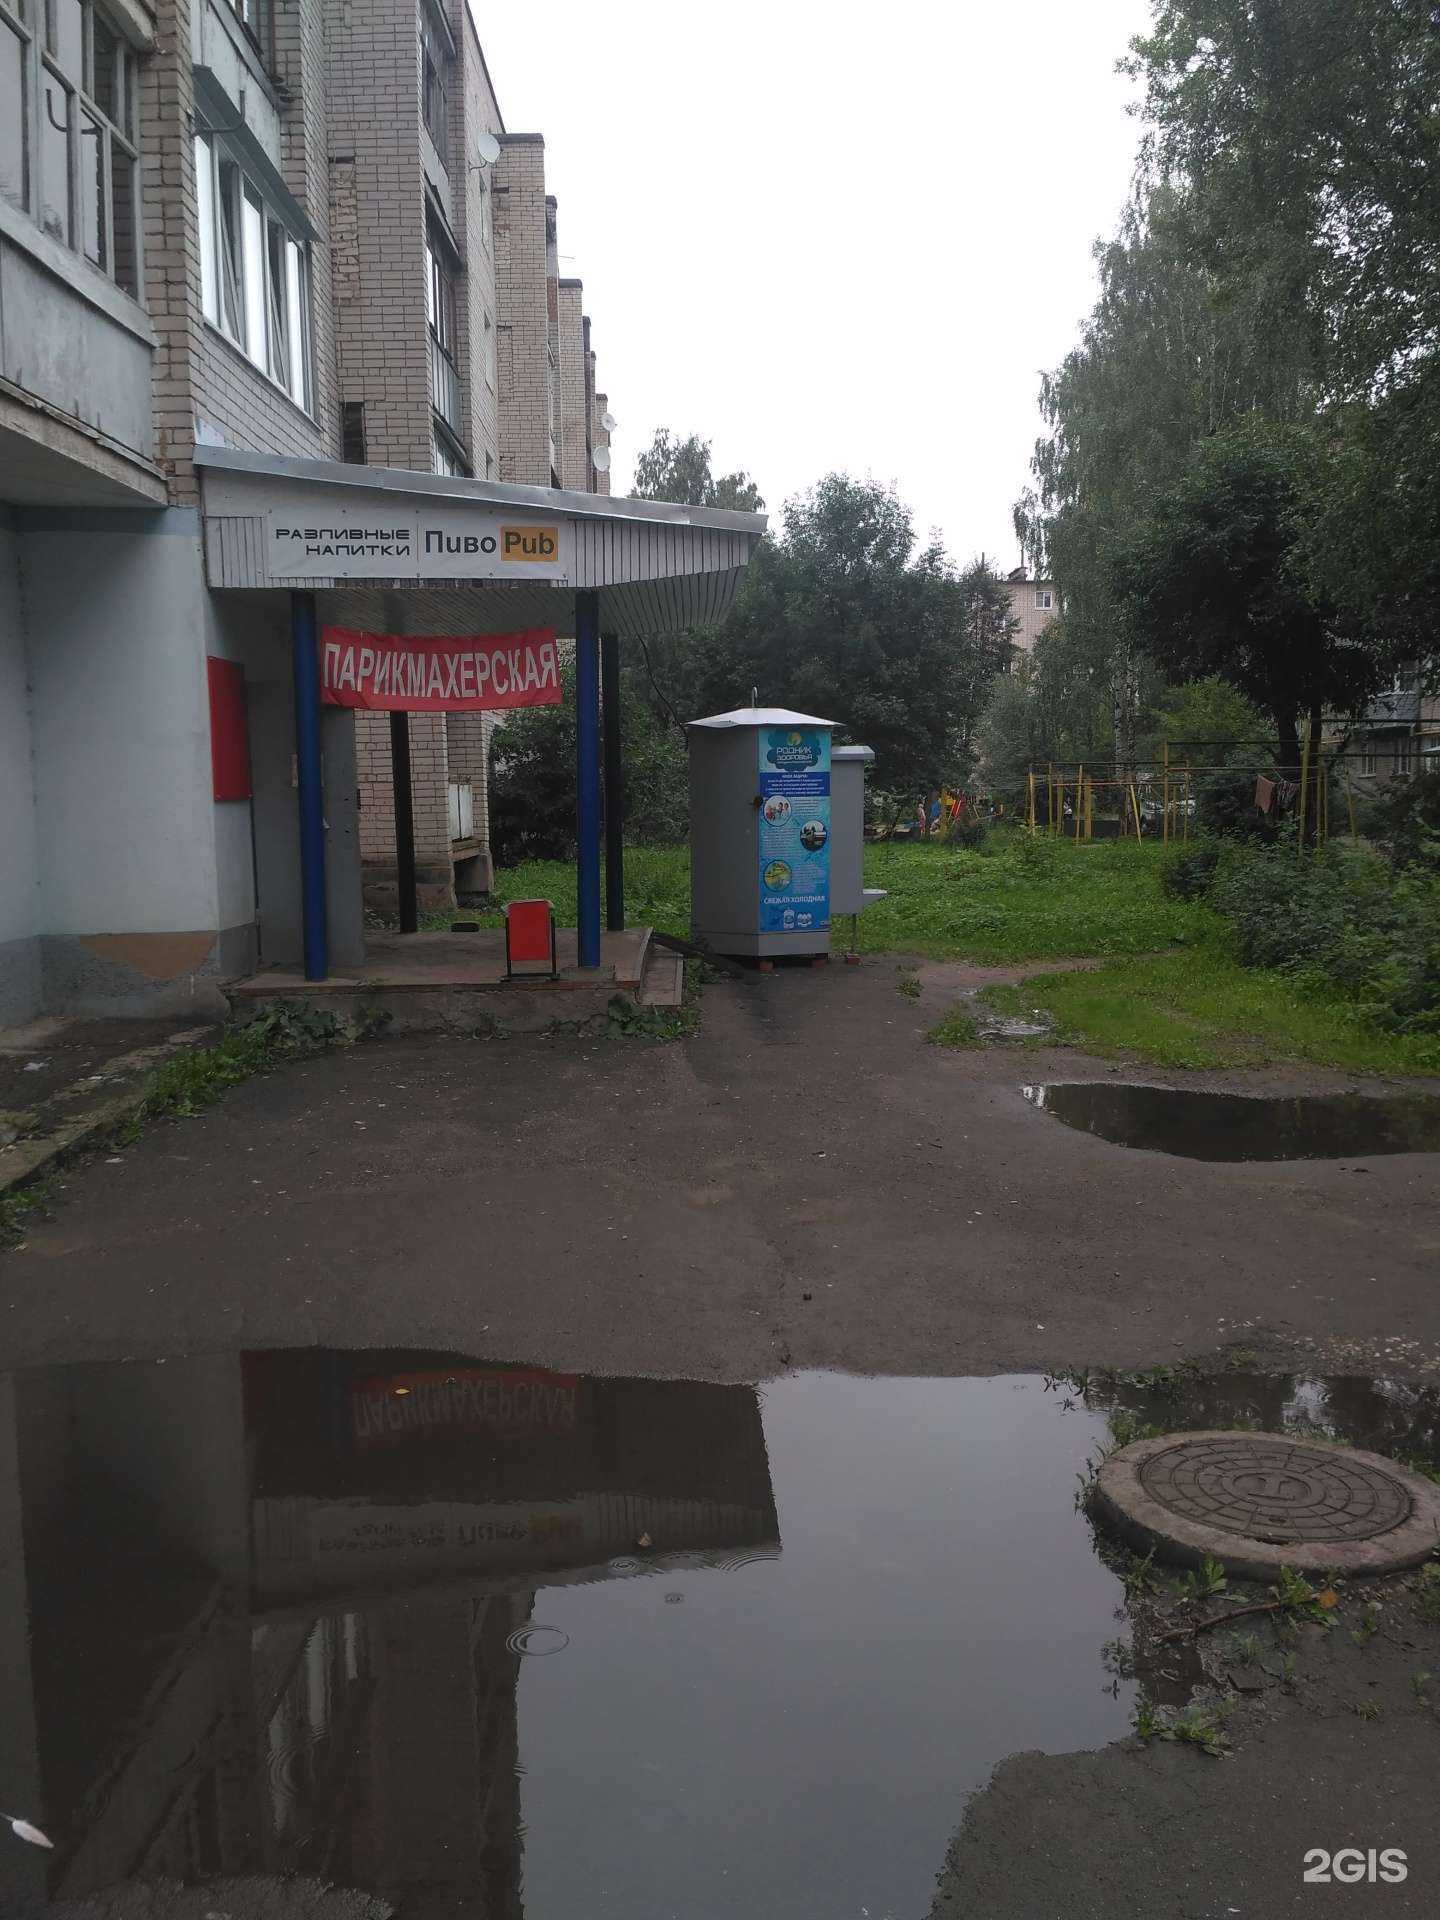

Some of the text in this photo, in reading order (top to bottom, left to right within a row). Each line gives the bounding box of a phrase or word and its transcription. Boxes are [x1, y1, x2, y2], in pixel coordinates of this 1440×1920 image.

[275, 528, 410, 540] РАЗЛИВНЫЕ
[425, 530, 555, 555] Пиво Pub
[305, 545, 410, 556] НАПИТКИ
[323, 642, 558, 698] ПАРИКМАХЕРСКАЯ
